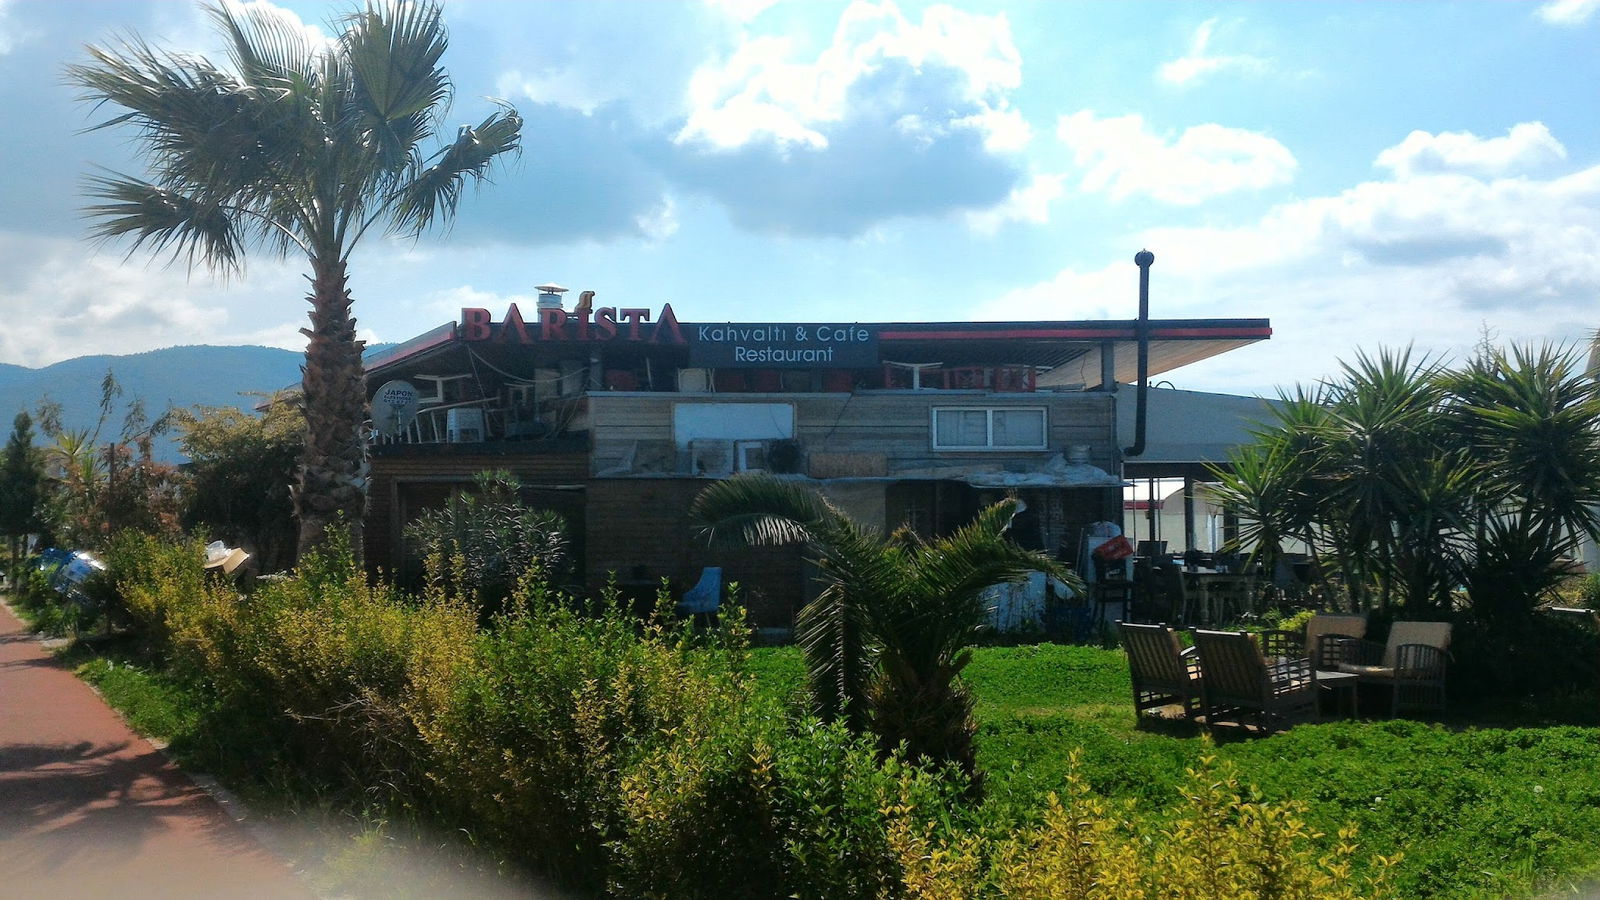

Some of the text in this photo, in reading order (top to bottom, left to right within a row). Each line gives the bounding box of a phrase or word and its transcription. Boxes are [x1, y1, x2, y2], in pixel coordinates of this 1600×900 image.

[795, 326, 809, 342] &
[816, 325, 870, 342] Cafe
[735, 346, 834, 362] Restaurant
[384, 389, 413, 397] JAPON
